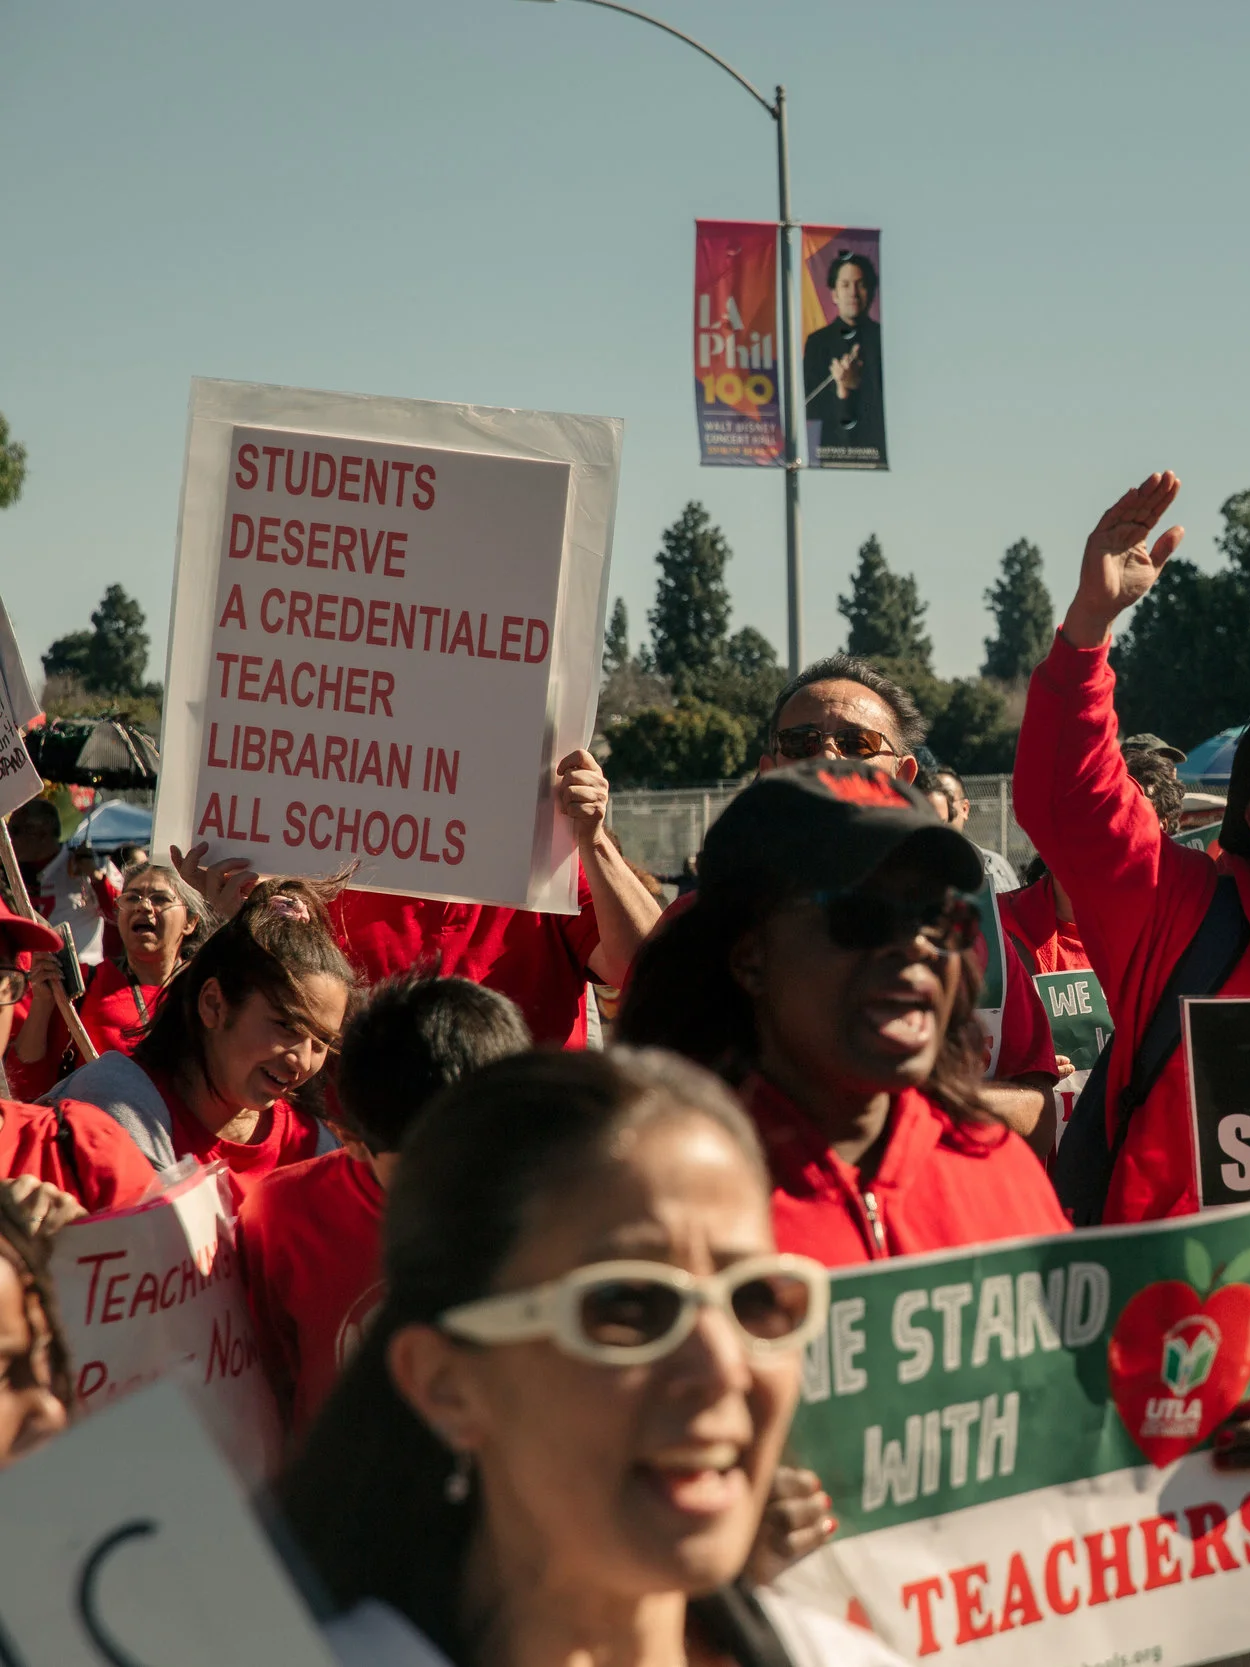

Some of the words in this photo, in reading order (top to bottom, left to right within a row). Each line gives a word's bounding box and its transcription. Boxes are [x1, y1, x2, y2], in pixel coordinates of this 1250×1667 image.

[699, 294, 745, 330] LA
[700, 331, 773, 369] Phil
[702, 373, 774, 405] 100
[704, 420, 732, 433] WALT
[235, 443, 437, 511] STUDENTS
[229, 513, 408, 577] DESERVE
[219, 583, 247, 630] A
[260, 588, 549, 664] CREDENTIALED
[216, 652, 395, 717] TEACHER
[207, 722, 412, 789] LIBRARIAN
[423, 747, 460, 795] IN
[198, 792, 270, 843] ALL
[282, 801, 467, 865] SCHOOLS
[1048, 981, 1093, 1017] WE
[891, 1262, 1110, 1384] STAND
[1145, 1397, 1203, 1420] UTLA
[862, 1391, 1020, 1513] WITH
